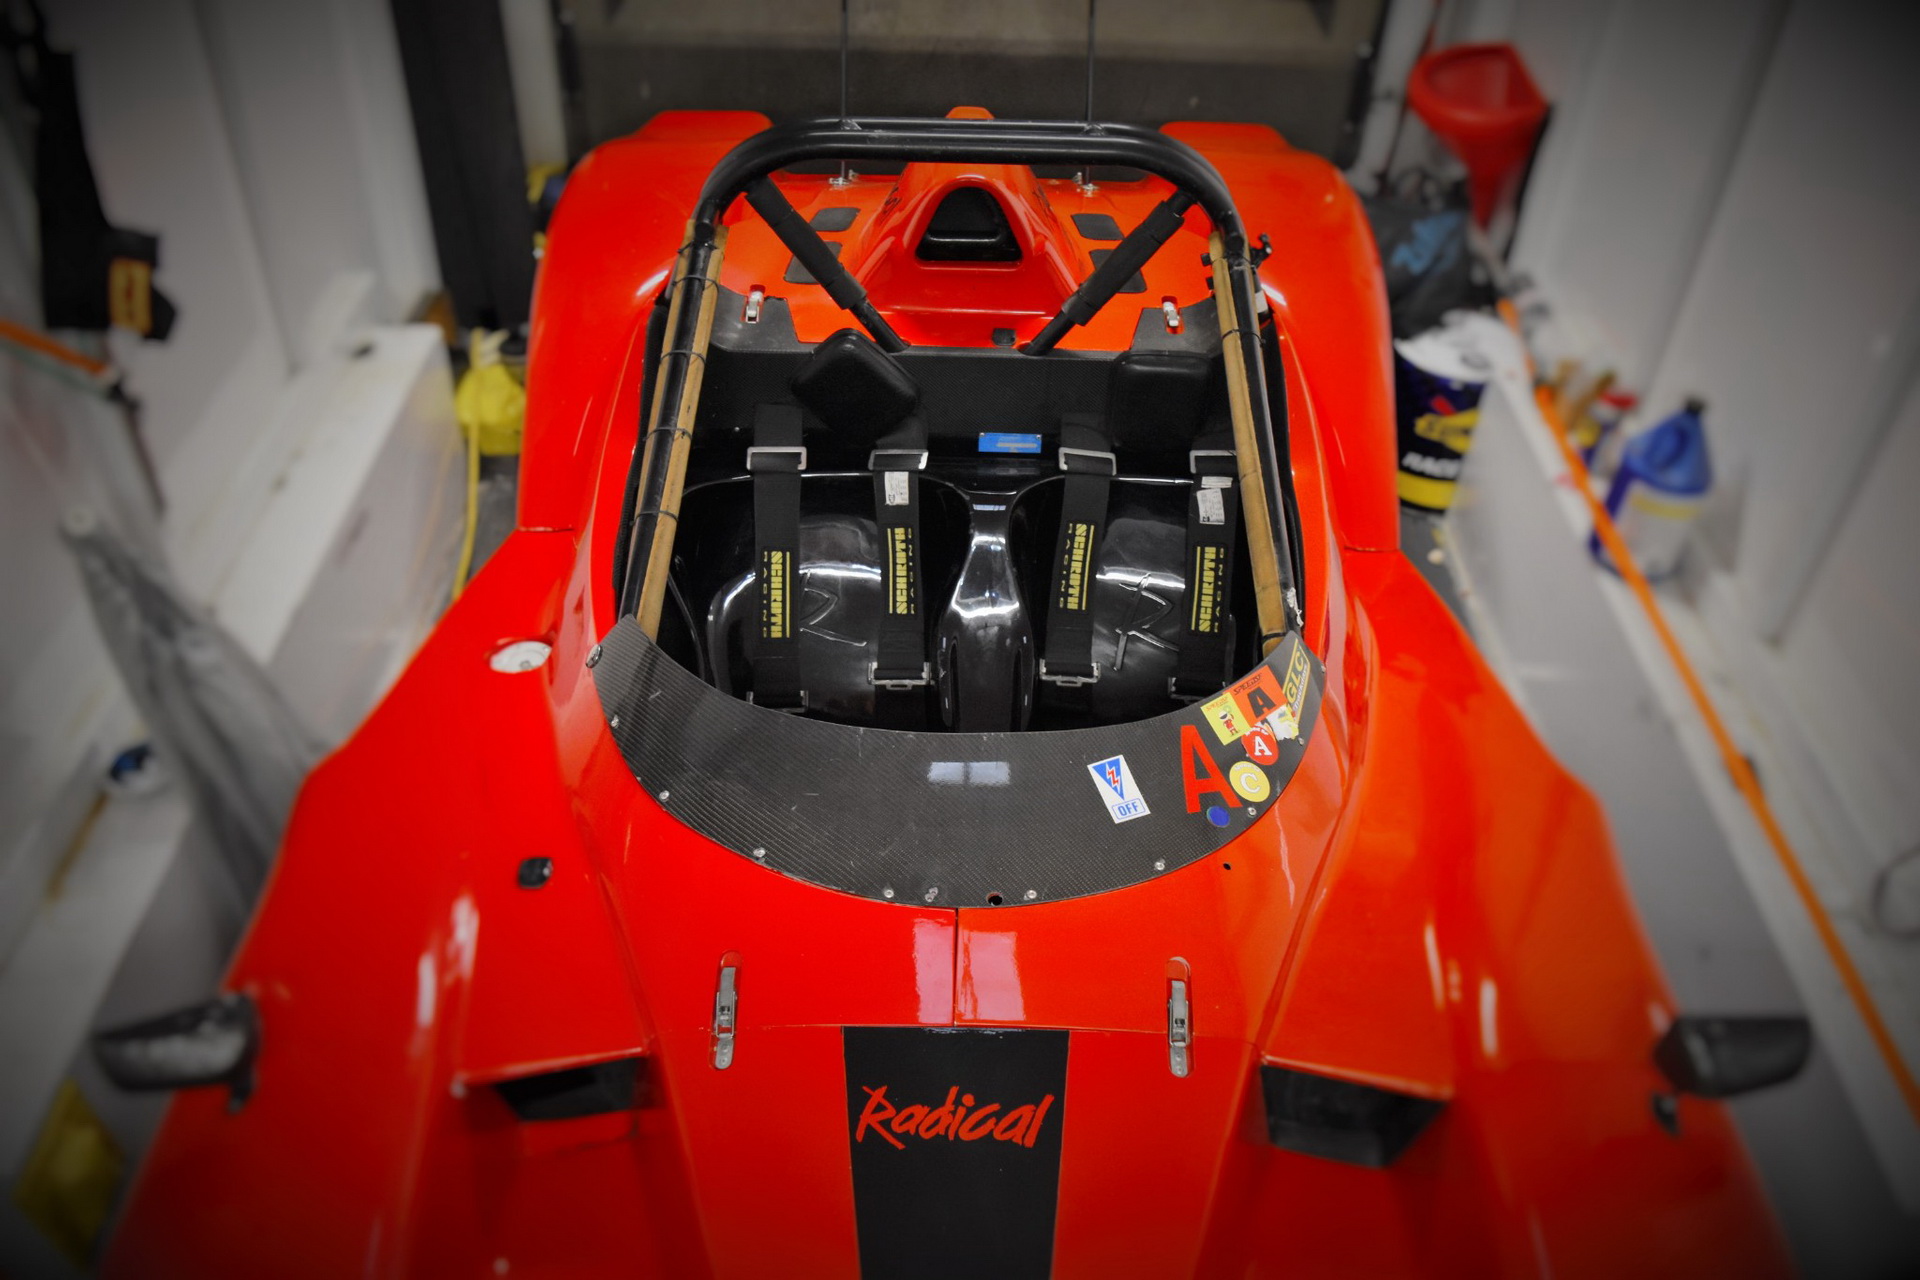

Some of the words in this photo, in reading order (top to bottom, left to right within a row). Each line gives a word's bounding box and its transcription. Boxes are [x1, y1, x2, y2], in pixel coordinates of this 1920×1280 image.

[770, 551, 783, 638] SCHROTH
[894, 527, 908, 614] SCHROTH
[1067, 523, 1087, 610] SCHROTH
[1198, 546, 1216, 632] SCHROTH
[1247, 686, 1276, 719] A
[1286, 651, 1304, 703] GLC
[1180, 724, 1243, 814] A
[1254, 735, 1273, 756] A
[1117, 801, 1138, 816] OFF
[1240, 773, 1261, 793] C
[855, 1085, 1055, 1150] Radical
